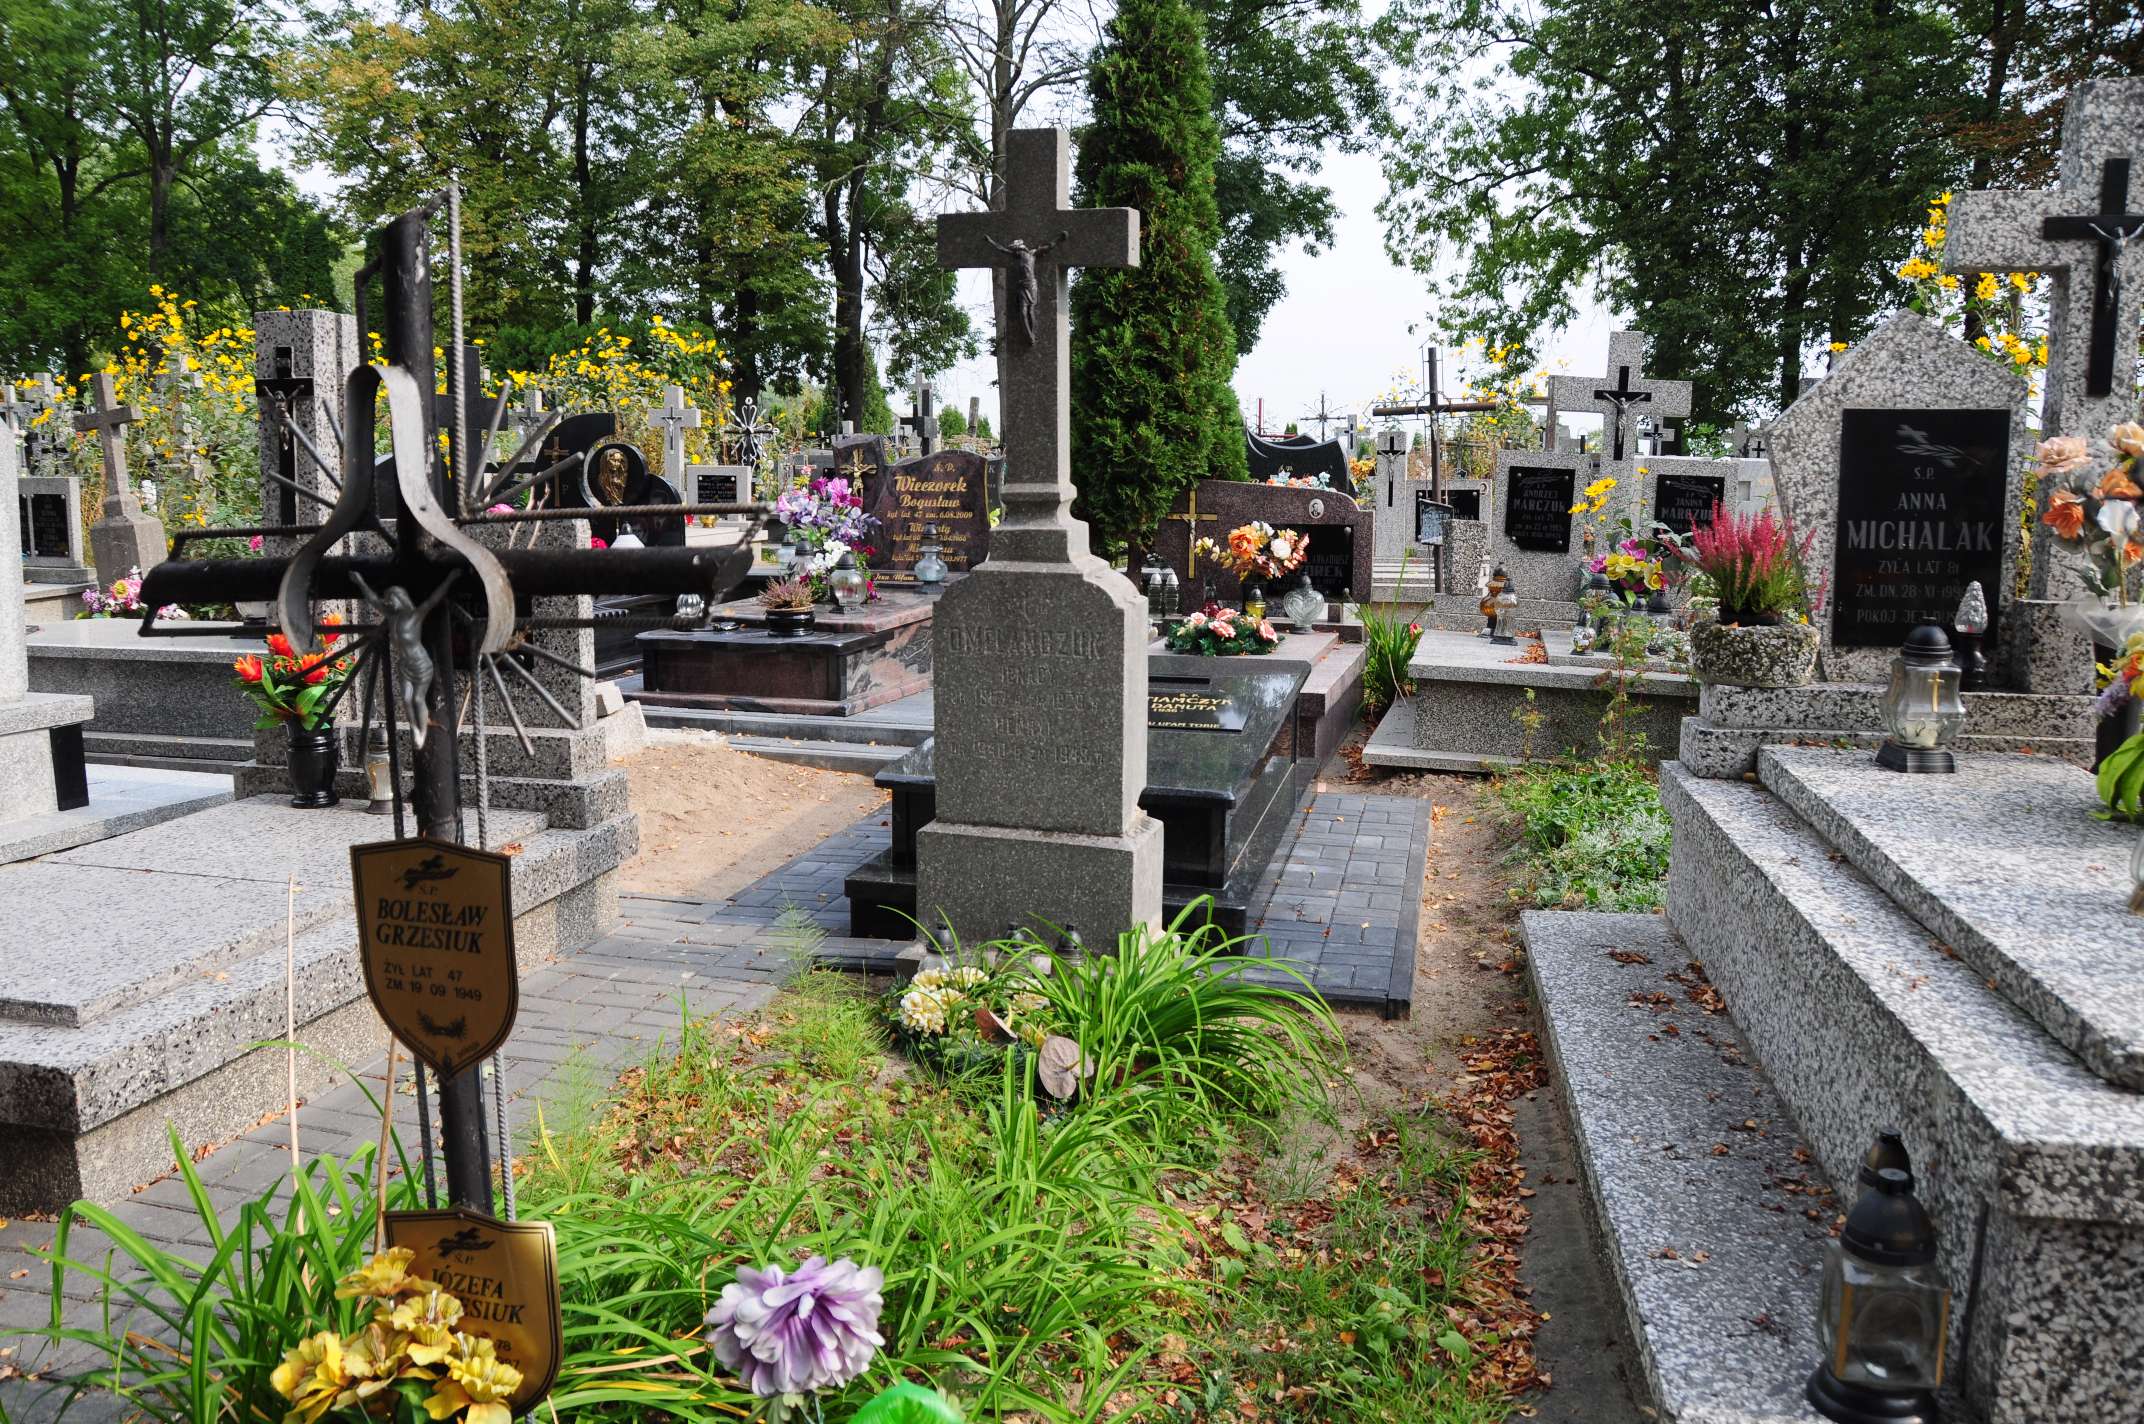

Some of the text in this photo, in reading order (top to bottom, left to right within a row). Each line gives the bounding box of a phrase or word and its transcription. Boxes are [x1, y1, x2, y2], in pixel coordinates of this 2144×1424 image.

[894, 475, 968, 492] Wieczorek
[1513, 498, 1567, 513] MARCZUK
[1897, 492, 1947, 511] ANNA
[1847, 520, 1994, 551] MICHALAK
[1916, 559, 1942, 575] LAT
[1151, 703, 1217, 711] DANUTA
[378, 899, 488, 927] BOLESŁAW
[376, 923, 484, 953] GRZESIUK
[411, 964, 433, 978] LAT
[447, 970, 464, 982] 47
[410, 981, 422, 993] 19
[430, 984, 446, 997] 09
[455, 987, 482, 1001] 1949
[431, 1265, 504, 1299] JÓZEFA
